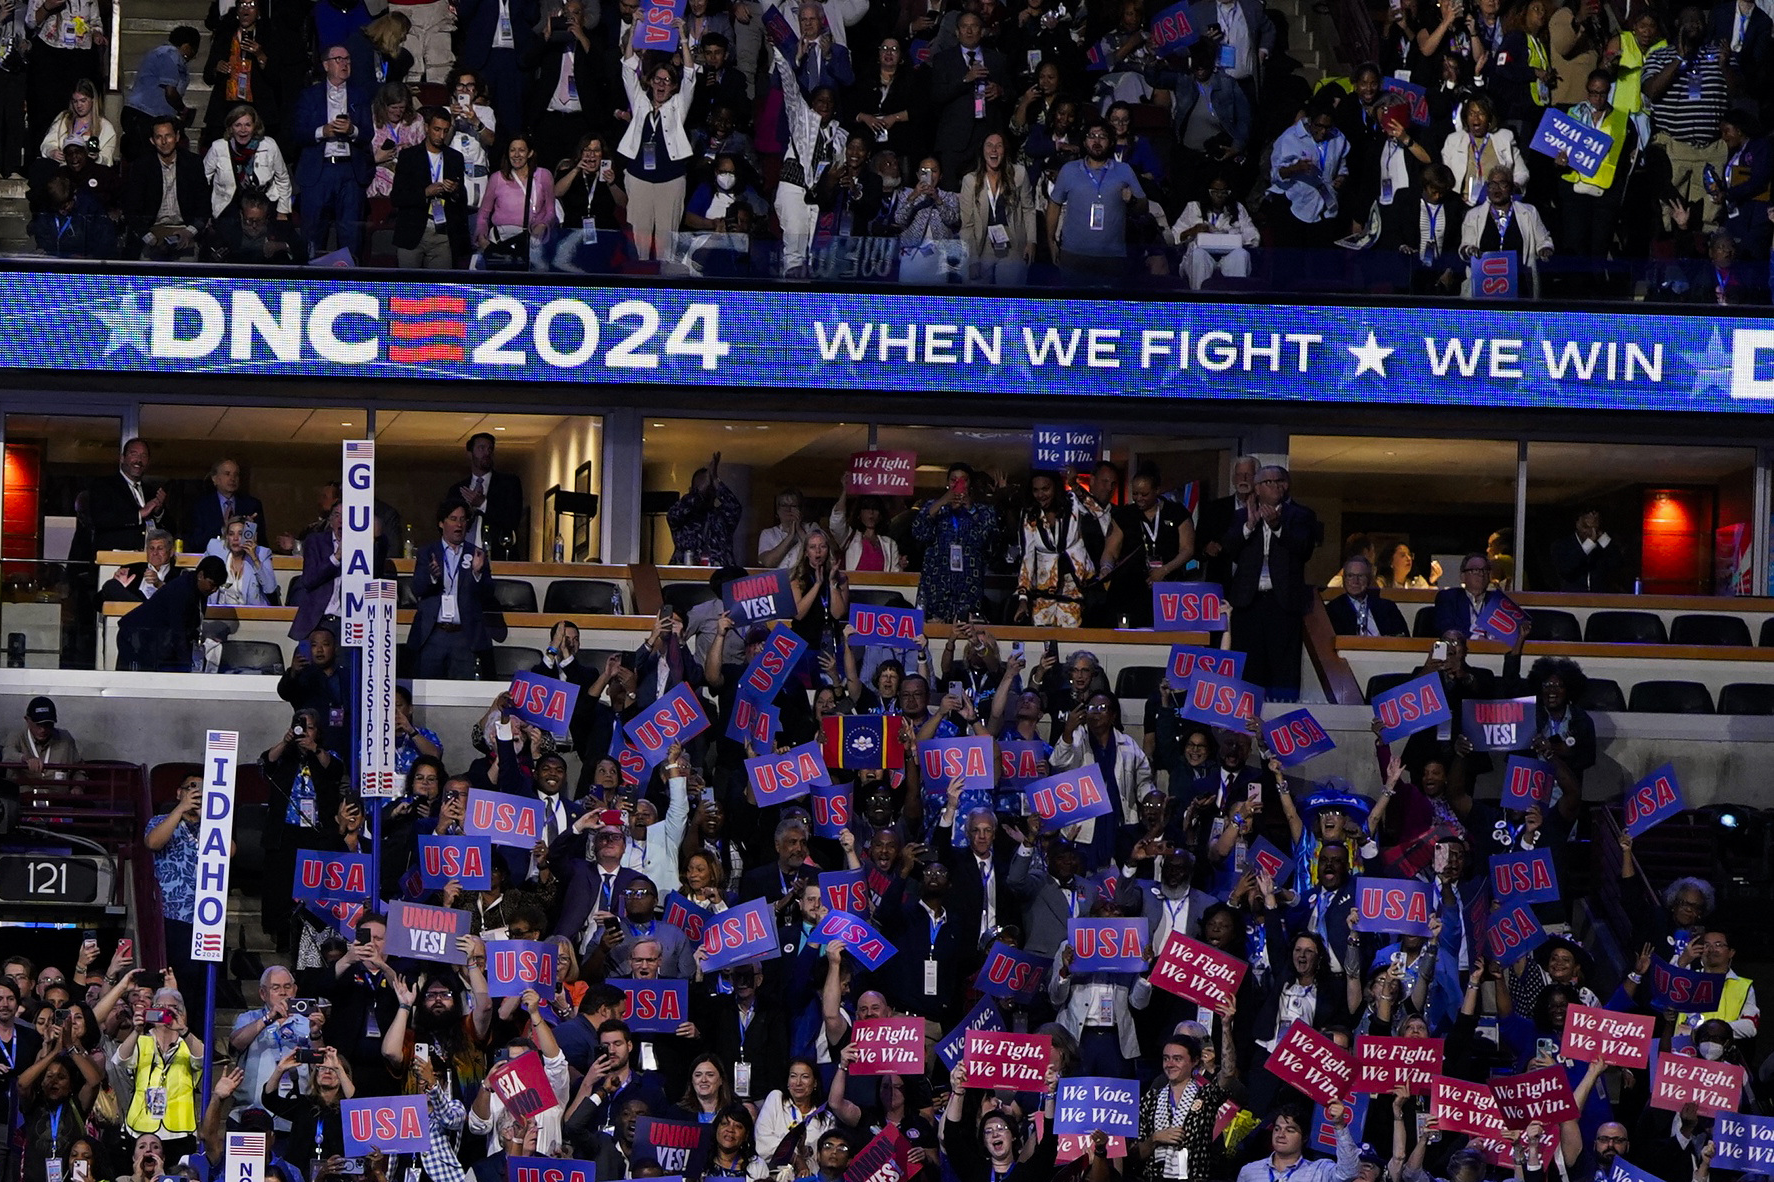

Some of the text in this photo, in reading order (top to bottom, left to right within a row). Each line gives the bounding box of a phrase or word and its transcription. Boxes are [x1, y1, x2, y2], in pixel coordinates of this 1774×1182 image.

[813, 320, 1663, 383] WHEN WE FIGHT WE WIN
[731, 574, 780, 600] UNION
[740, 596, 776, 616] YES!
[1160, 593, 1223, 621] USA
[855, 611, 916, 639] USA
[1380, 685, 1440, 727] USA
[1475, 704, 1524, 723] UNION
[636, 697, 697, 749] USA
[1484, 724, 1516, 746] YES!
[1034, 777, 1102, 819] USA
[1625, 778, 1675, 825] USA
[197, 757, 231, 926] IDAHO
[27, 862, 67, 894] 121
[302, 859, 365, 893] USA
[402, 905, 457, 932] UNION
[1362, 889, 1427, 923] USA
[410, 930, 447, 955] YES!
[822, 916, 882, 961] USA
[495, 951, 552, 985] USA
[1573, 1012, 1645, 1039] We Fight,
[971, 1038, 1044, 1060] We Fight,
[1570, 1033, 1642, 1057] We Win.
[970, 1060, 1043, 1080] We Win.
[1063, 1086, 1133, 1104] We Vote,
[350, 1107, 422, 1141] USA
[1061, 1108, 1132, 1125] We Win.
[650, 1122, 701, 1149] UNION
[657, 1148, 690, 1171] YES!
